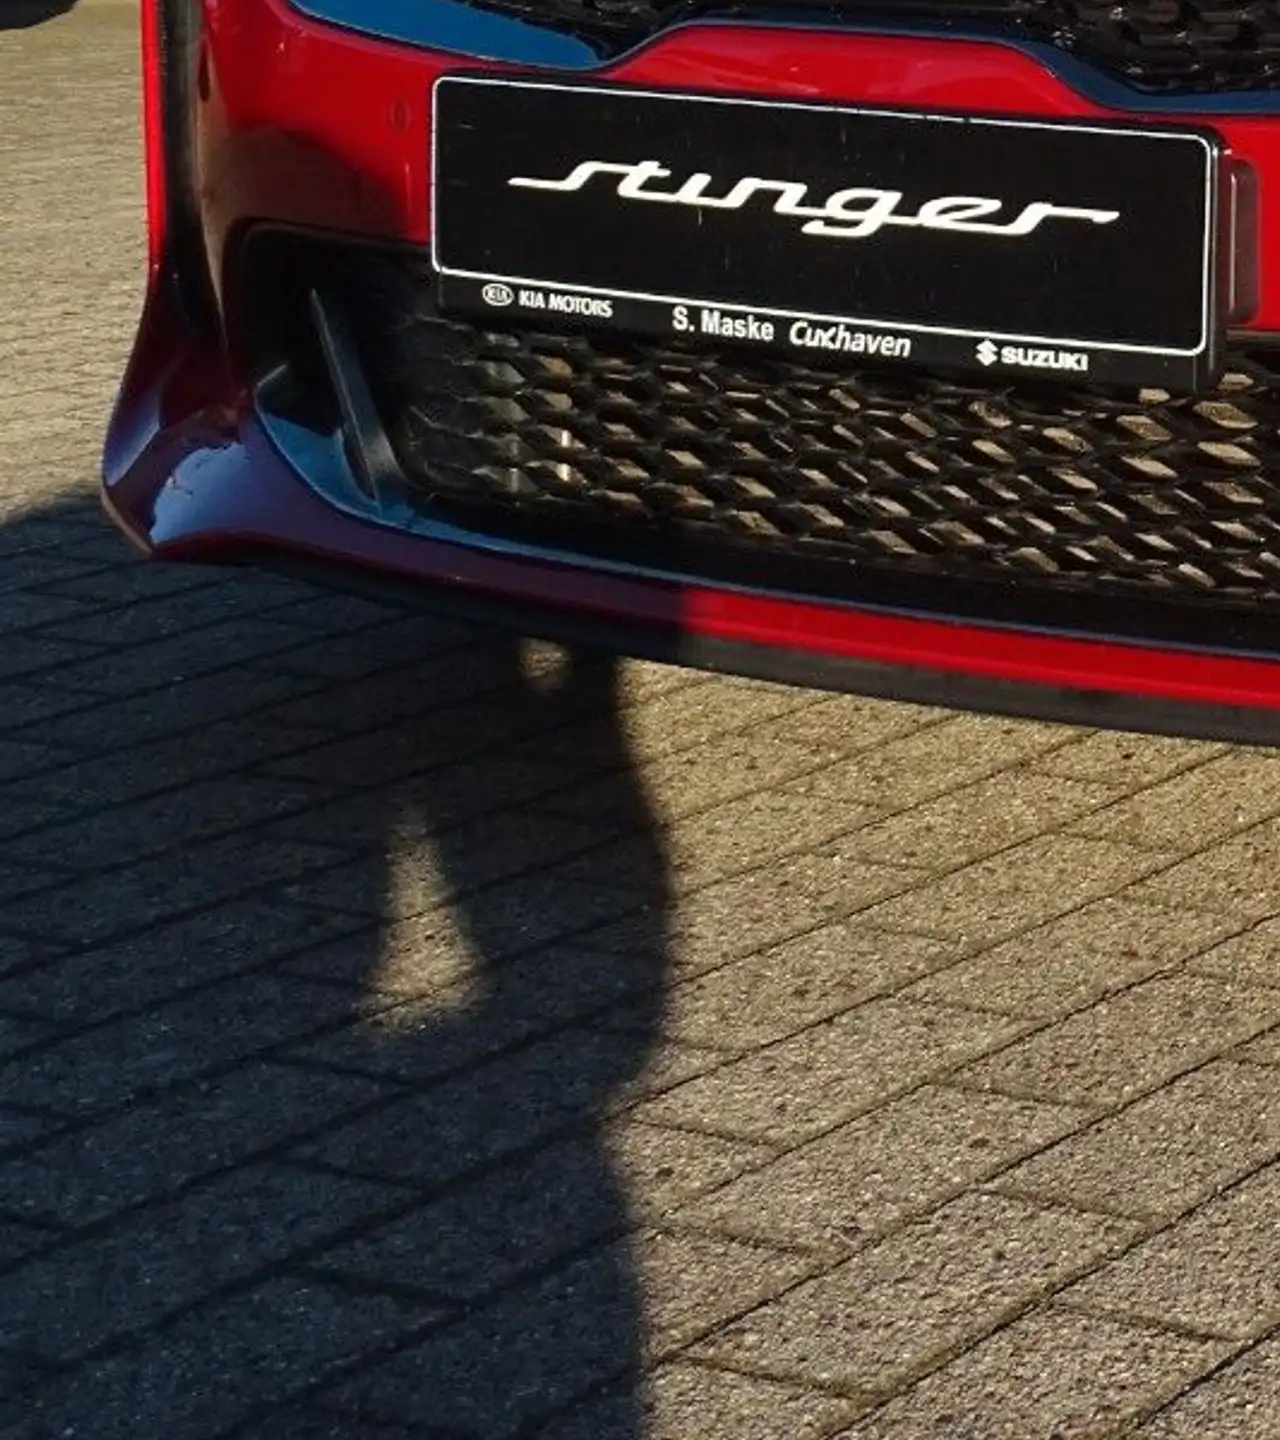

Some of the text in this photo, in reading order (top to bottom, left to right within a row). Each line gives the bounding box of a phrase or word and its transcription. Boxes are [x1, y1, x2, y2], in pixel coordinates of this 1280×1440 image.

[507, 159, 1120, 238] stinger
[483, 284, 512, 305] KIA
[518, 289, 613, 318] KIA MOTORS
[671, 304, 911, 358] S. Maske Cuxhaven
[999, 345, 1089, 371] SUZUKI
